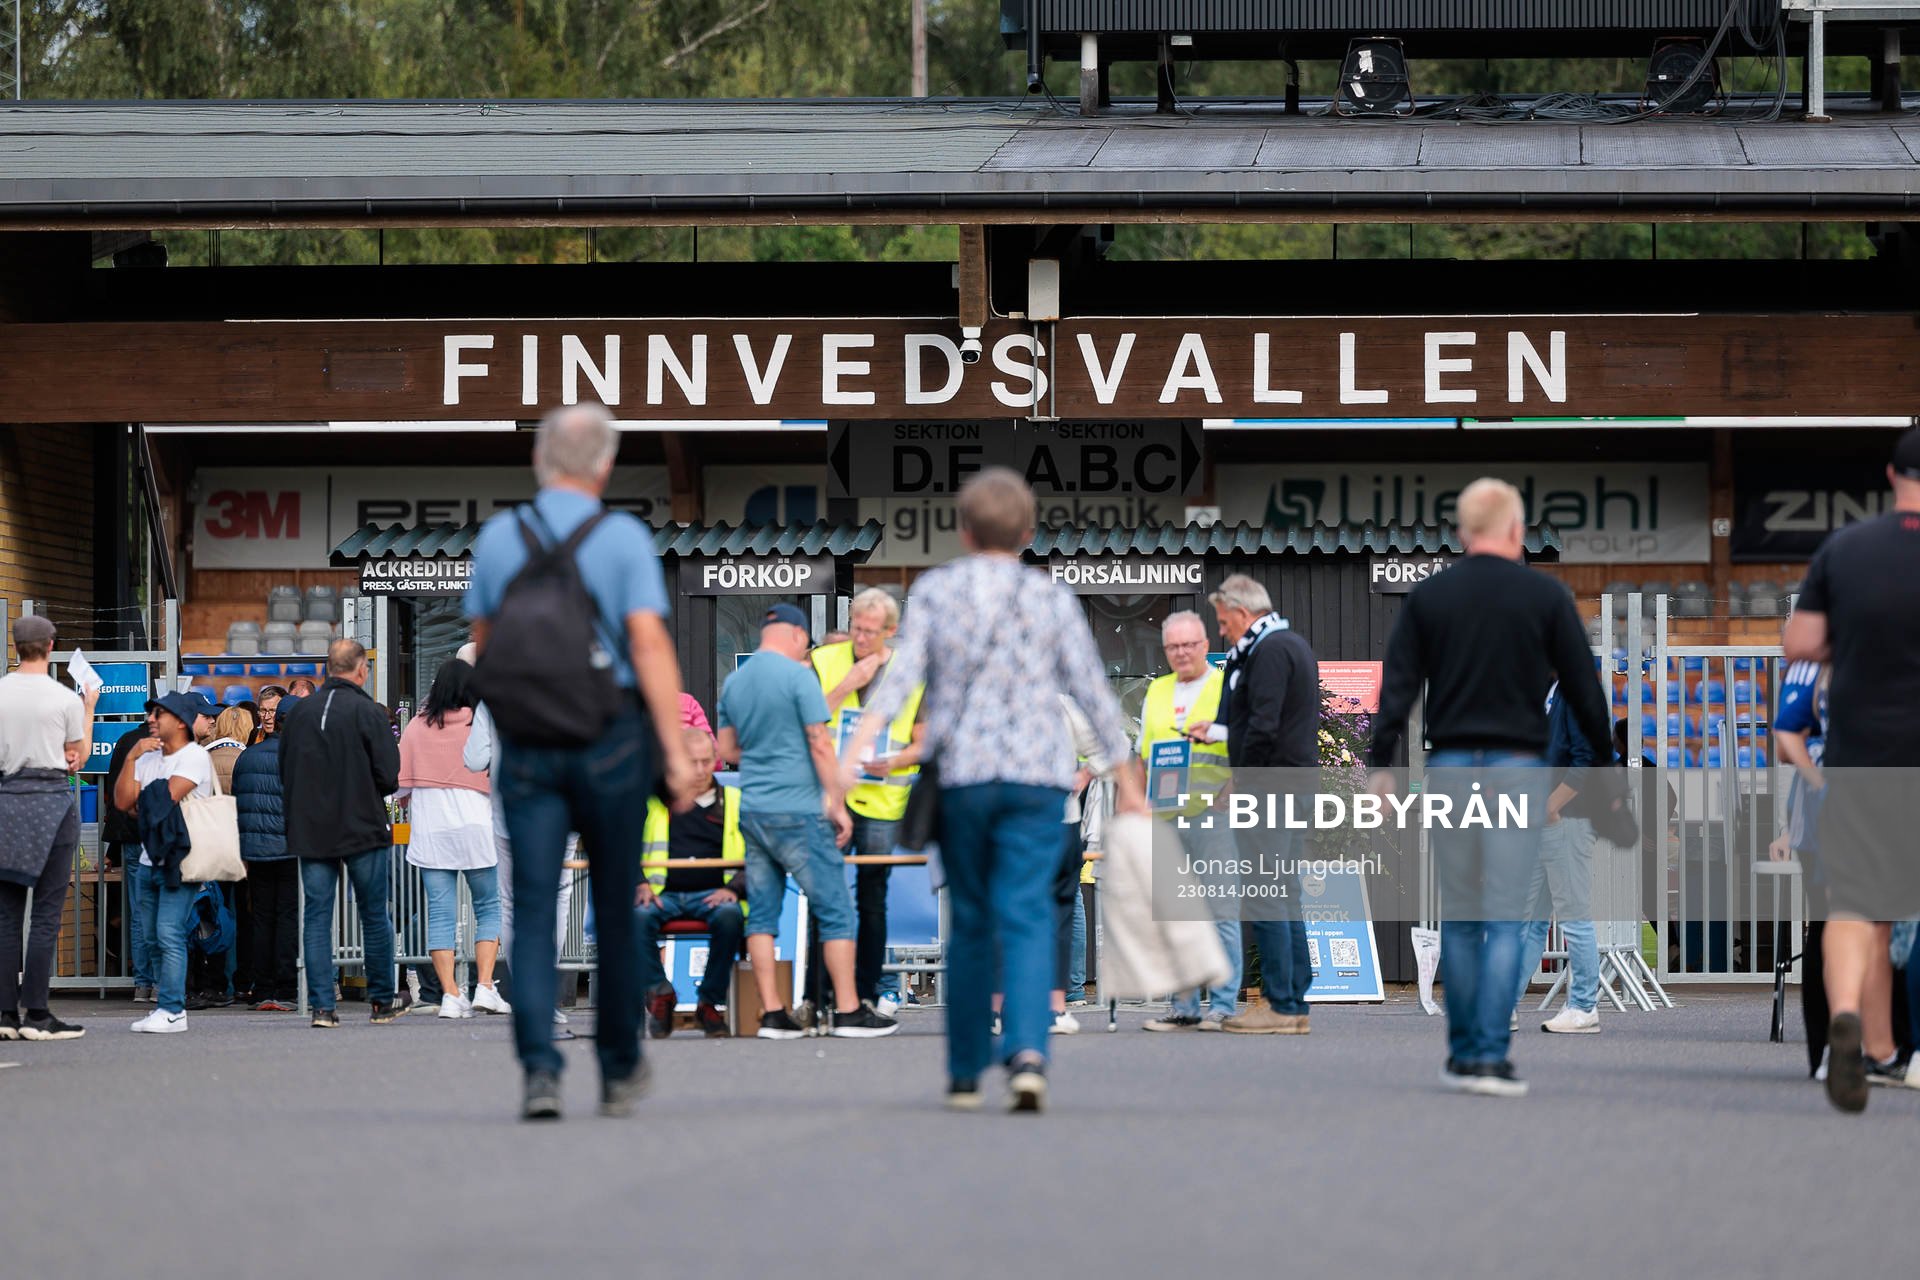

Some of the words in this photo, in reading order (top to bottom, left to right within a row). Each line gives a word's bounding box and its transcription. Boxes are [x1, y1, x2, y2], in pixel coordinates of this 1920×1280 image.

[443, 330, 1568, 407] FINNVEDSVALLEN
[894, 424, 980, 440] SEKTION
[1058, 423, 1144, 439] SEKTION
[1025, 444, 1177, 493] A.B.C
[204, 490, 300, 539] 3M
[1763, 491, 1896, 532] ZIN
[1562, 532, 1659, 556] roup
[362, 561, 477, 577] ACKREDITER
[703, 558, 812, 588] FÖRKÖP
[1051, 560, 1202, 585] FÖRSÄLJNING
[1372, 557, 1452, 583] FÖRSÄ
[362, 581, 395, 591] PRESS,
[396, 579, 436, 591] GÄSTER,
